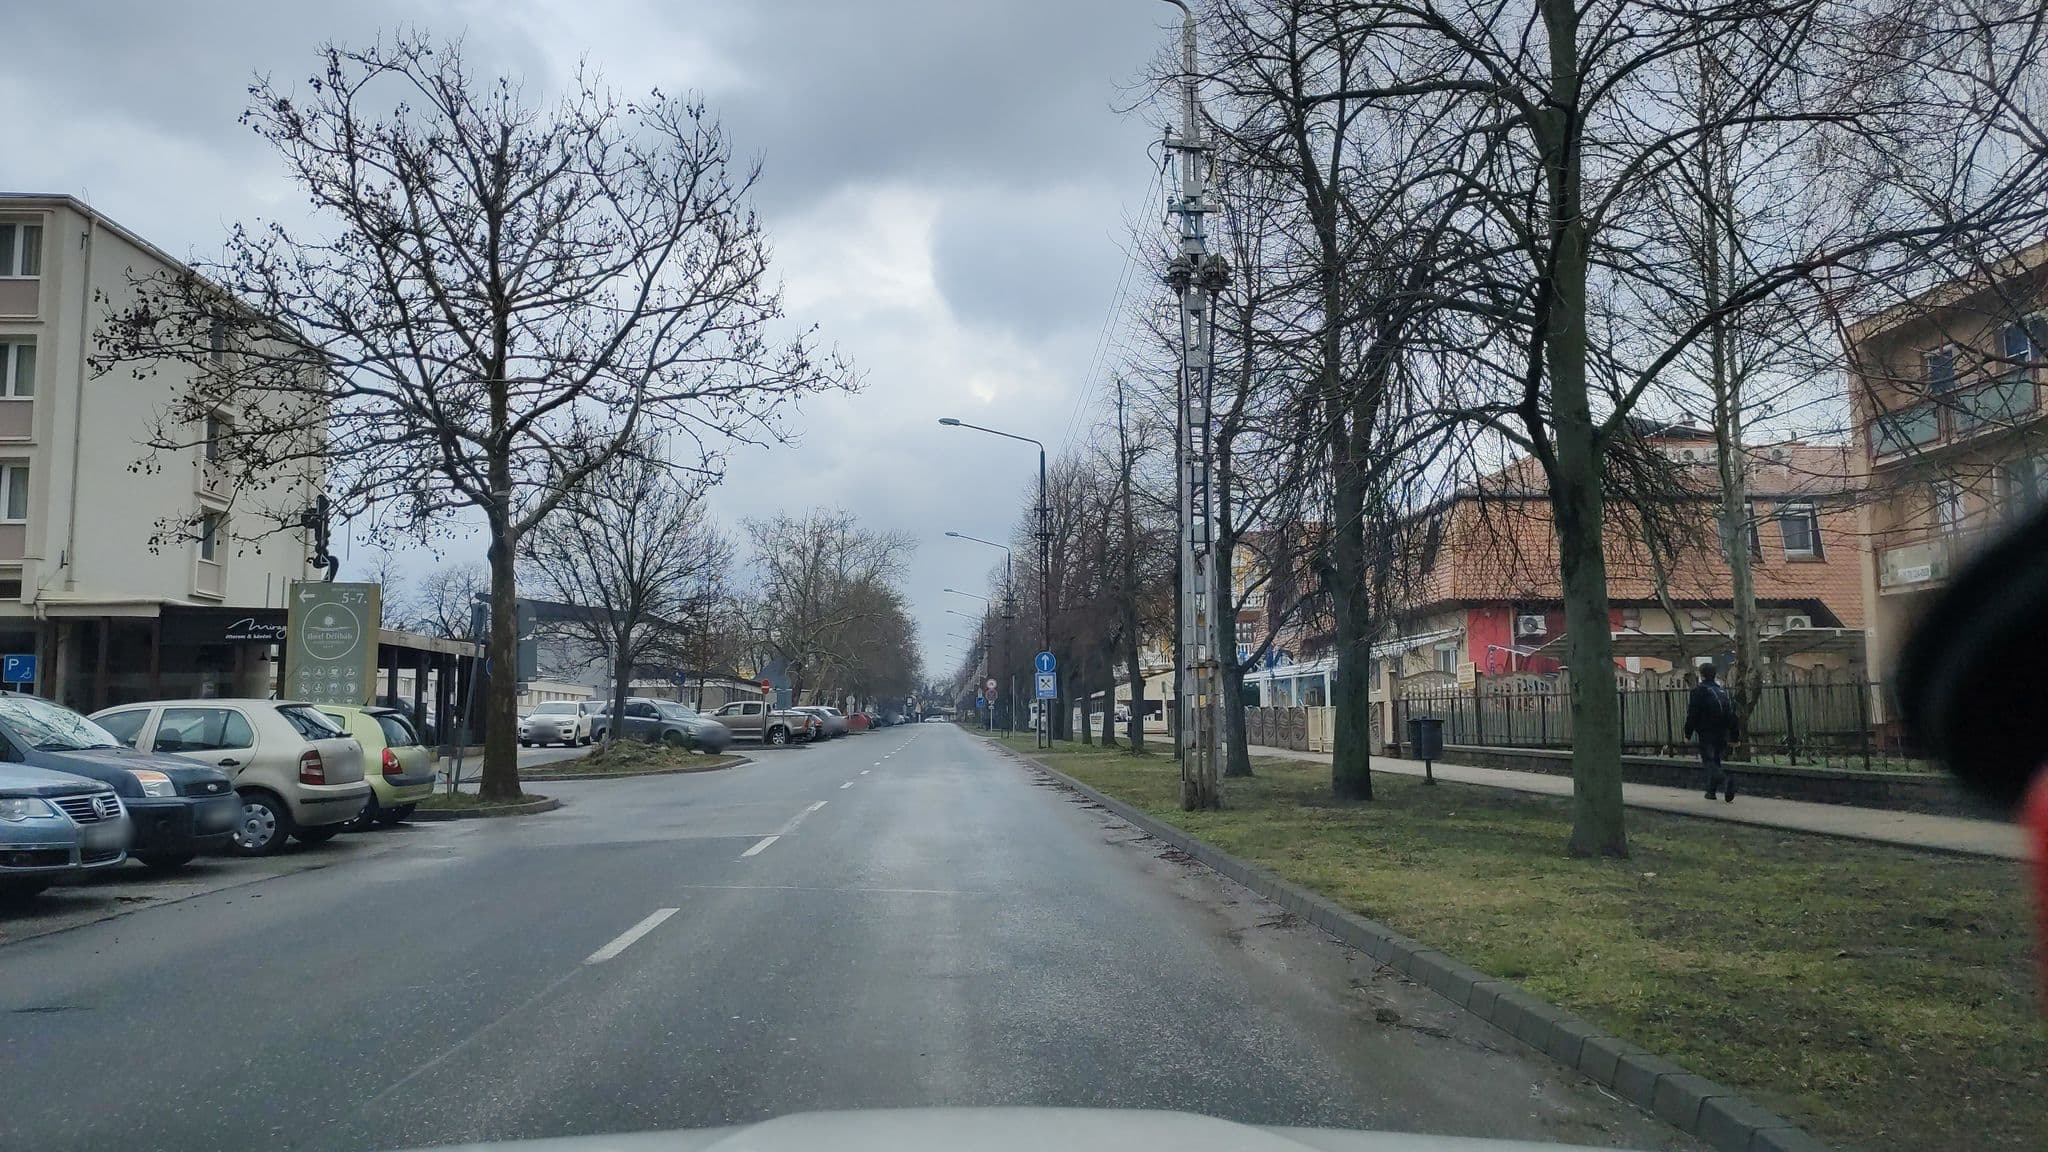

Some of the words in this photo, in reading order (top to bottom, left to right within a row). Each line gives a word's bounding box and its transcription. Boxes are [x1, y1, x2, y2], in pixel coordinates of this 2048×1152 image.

[342, 593, 367, 604] 5-7.
[227, 618, 288, 639] Mirag
[8, 659, 19, 671] P
